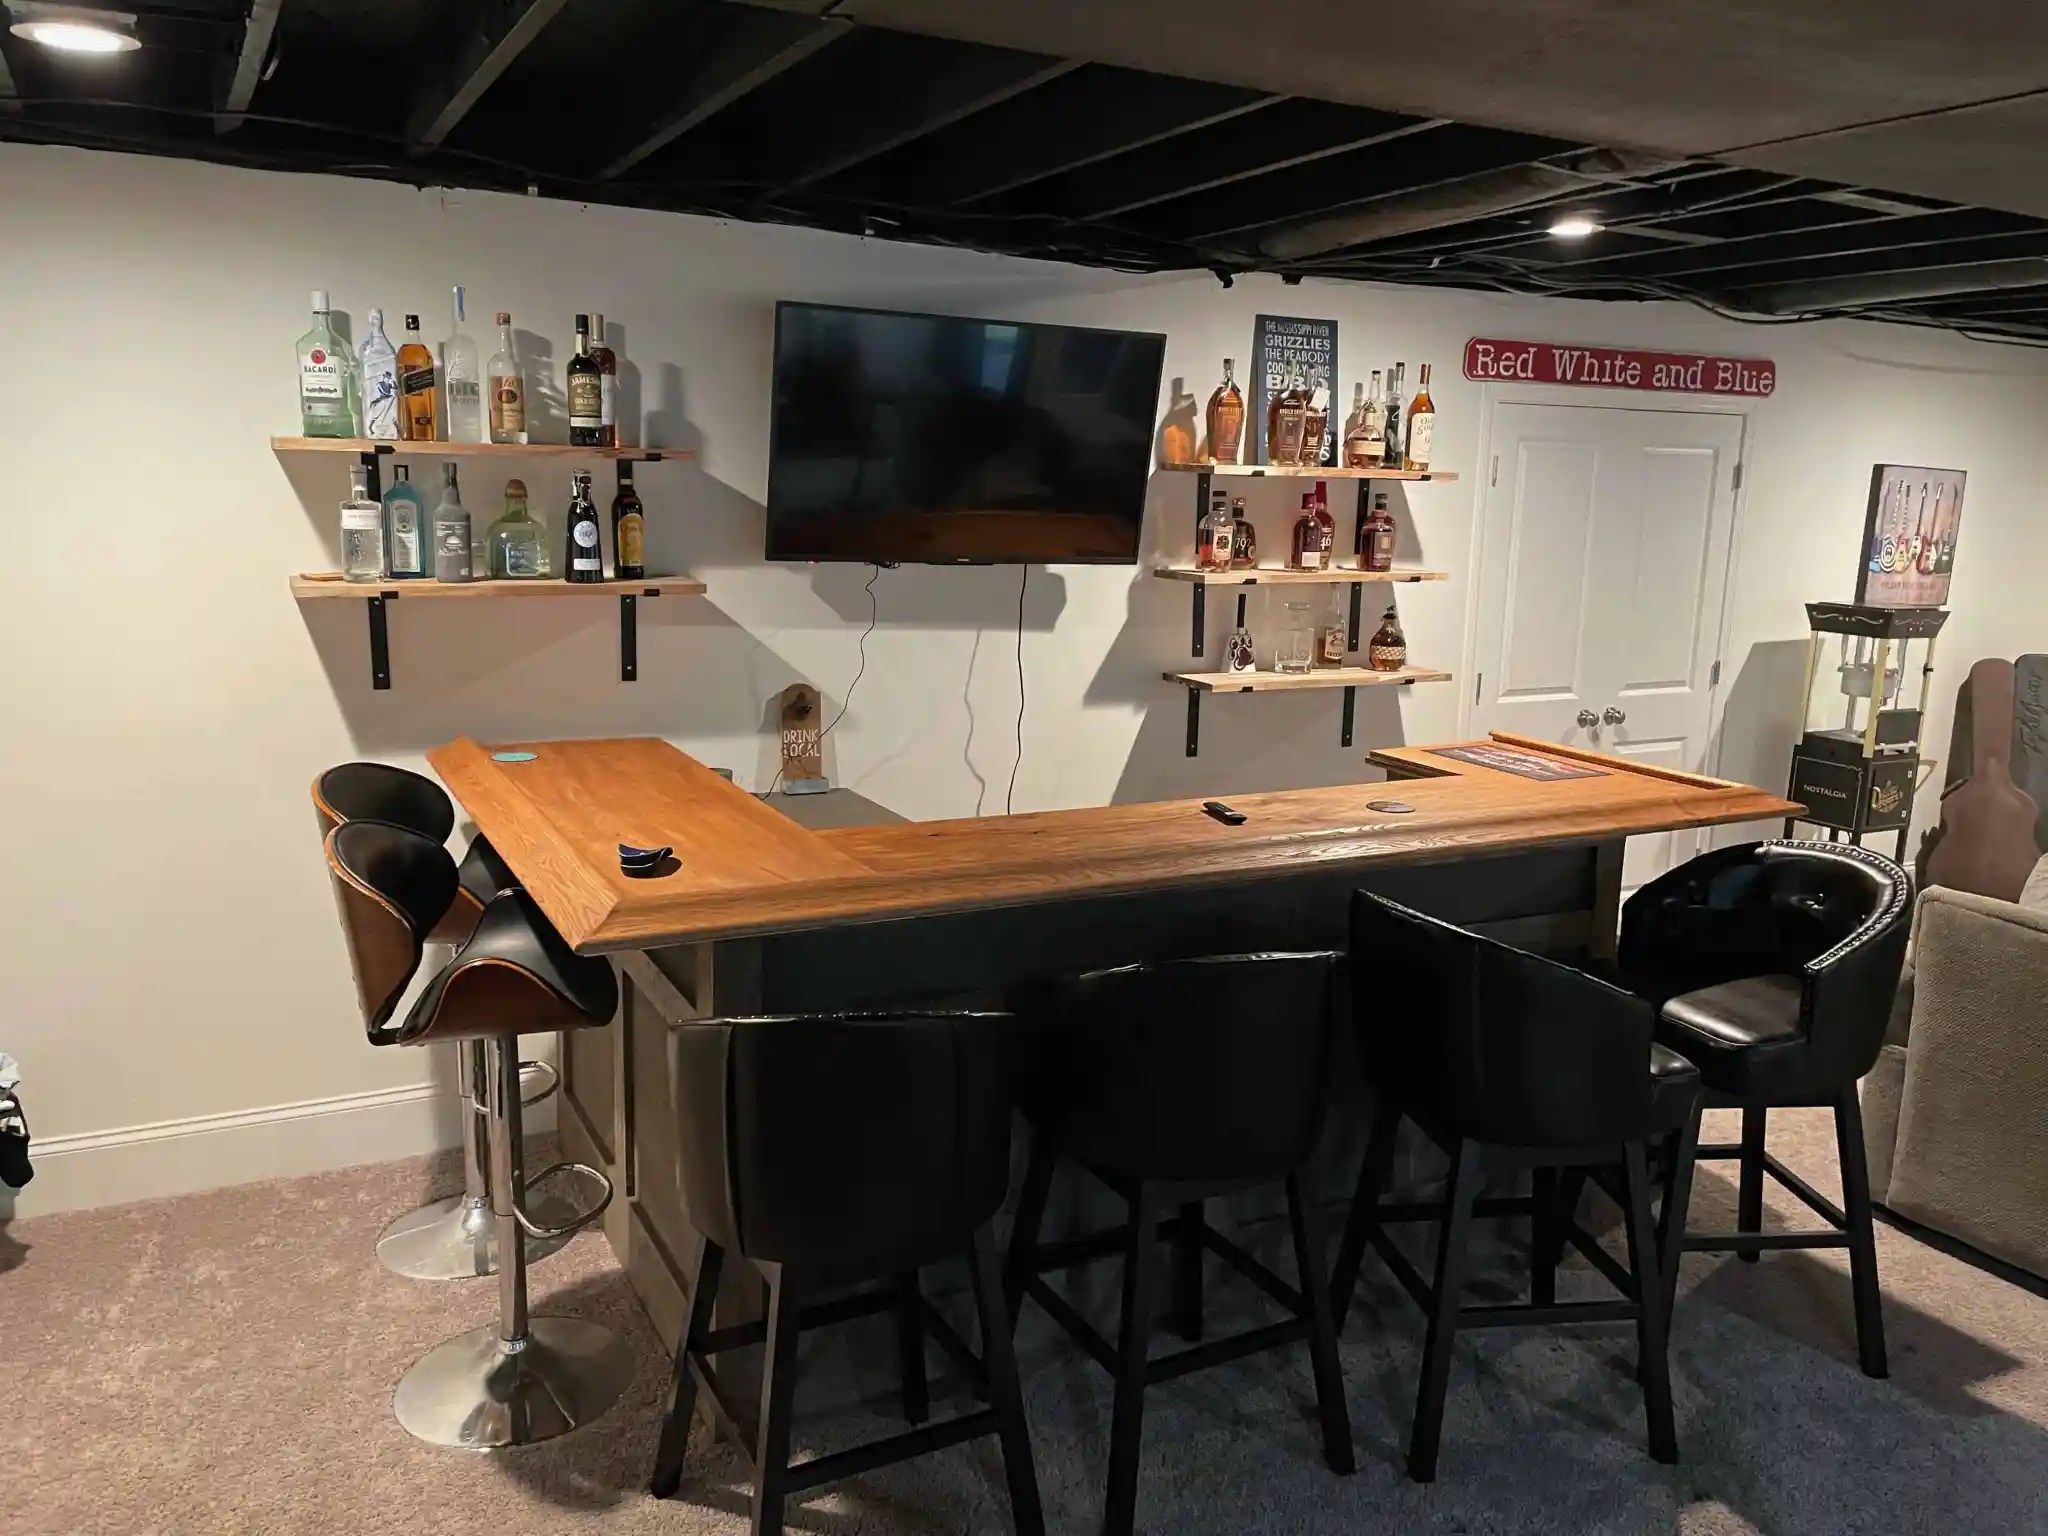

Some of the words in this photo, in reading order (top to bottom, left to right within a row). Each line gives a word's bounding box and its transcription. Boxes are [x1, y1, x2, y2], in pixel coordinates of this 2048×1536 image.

[1264, 334, 1331, 351] GRIZZLIES
[1264, 347, 1283, 360] THE
[1284, 349, 1331, 364] PEABODY
[1472, 344, 1537, 378] Red
[1552, 349, 1641, 386] White
[1652, 360, 1705, 390] and
[1713, 360, 1774, 394] Blue
[783, 729, 819, 743] DRINK
[783, 743, 820, 758] LOCAL
[1804, 784, 1847, 799] NOSTALGIA
